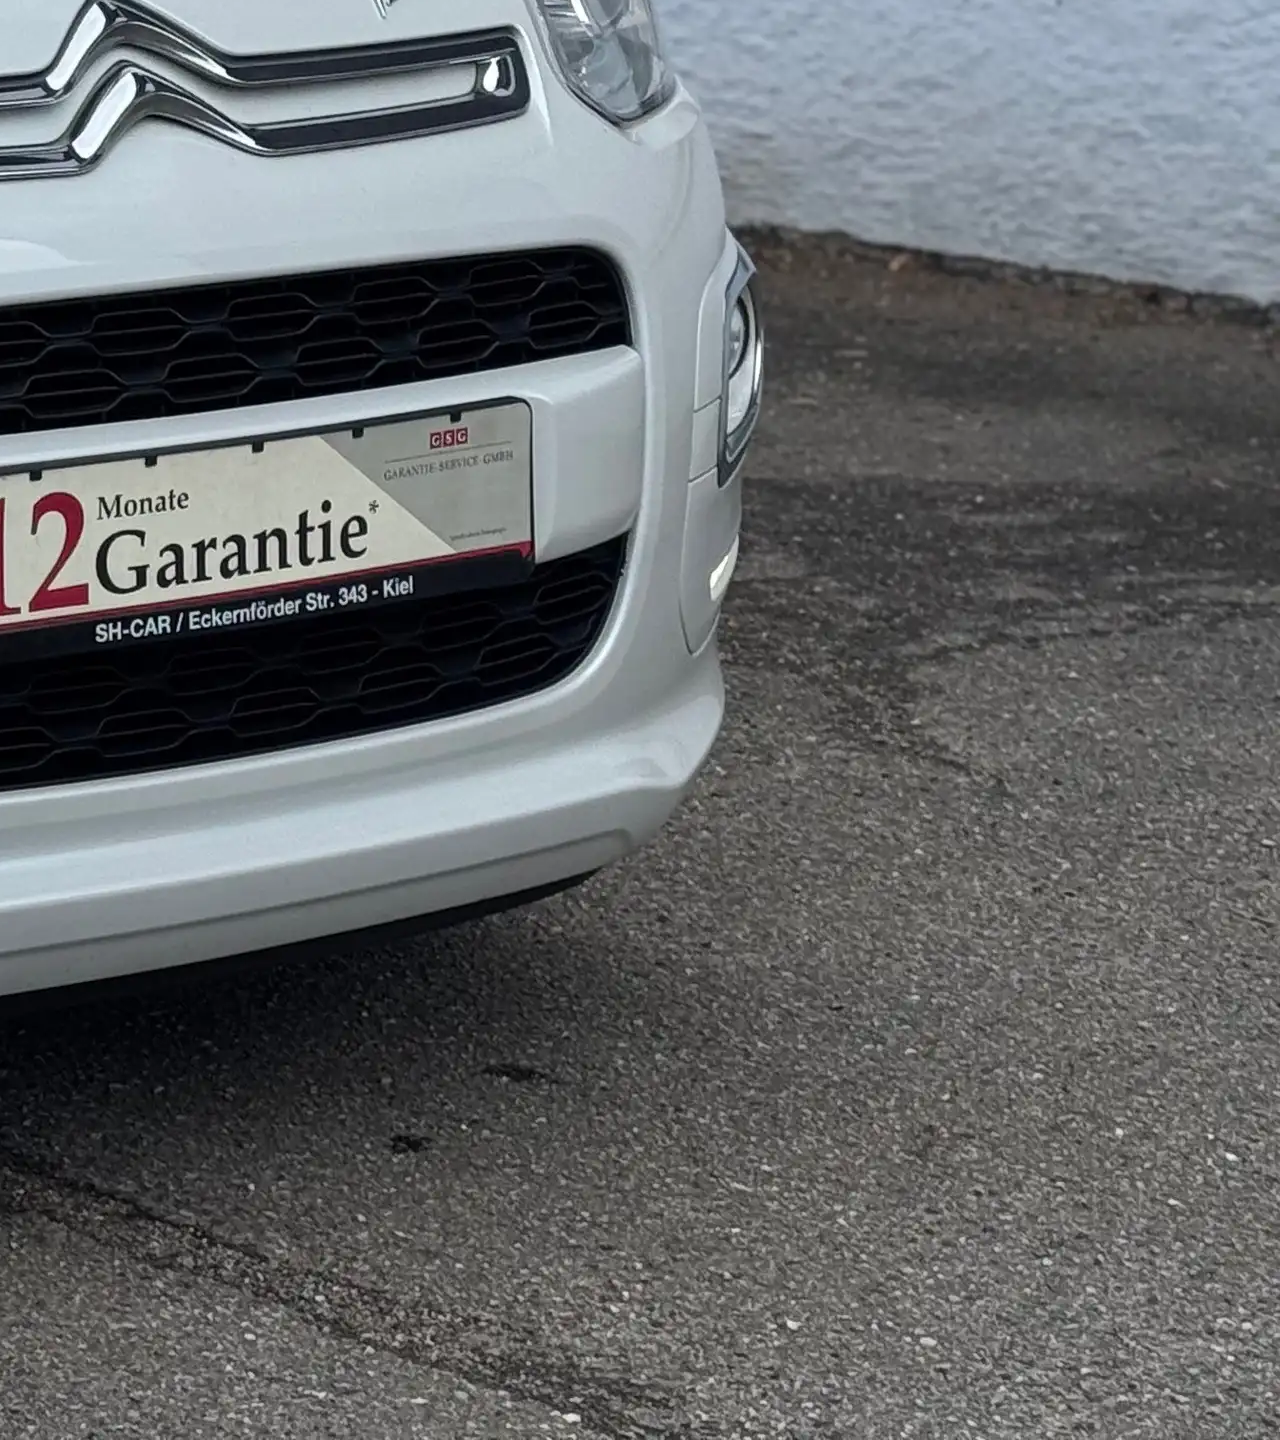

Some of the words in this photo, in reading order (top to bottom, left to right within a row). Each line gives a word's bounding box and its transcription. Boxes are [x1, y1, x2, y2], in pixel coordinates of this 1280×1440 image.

[430, 428, 468, 448] GSG
[95, 488, 190, 521] Monate
[95, 614, 172, 644] SH-CAR
[175, 612, 184, 633] /
[188, 598, 303, 630] Eckernförder
[305, 591, 336, 611] Str.
[338, 583, 369, 606] 343
[383, 575, 415, 599] Kiel
